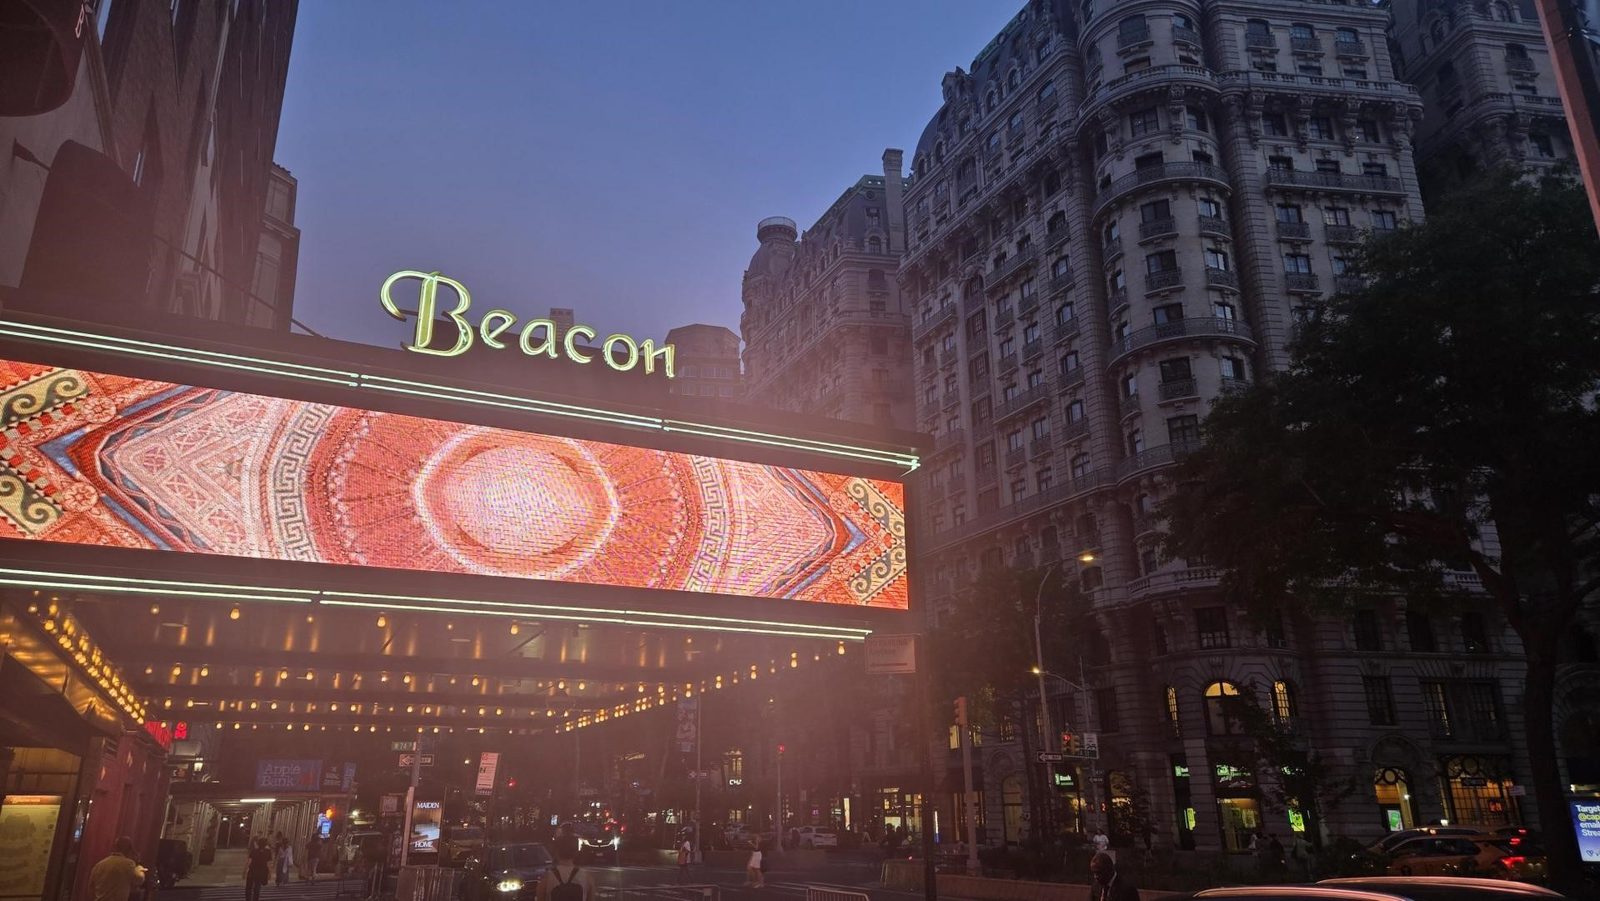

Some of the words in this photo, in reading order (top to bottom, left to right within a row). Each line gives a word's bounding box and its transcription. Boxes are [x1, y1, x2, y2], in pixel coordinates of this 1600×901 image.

[380, 271, 676, 378] Beacon
[263, 763, 301, 775] Apple
[260, 775, 295, 787] Bank
